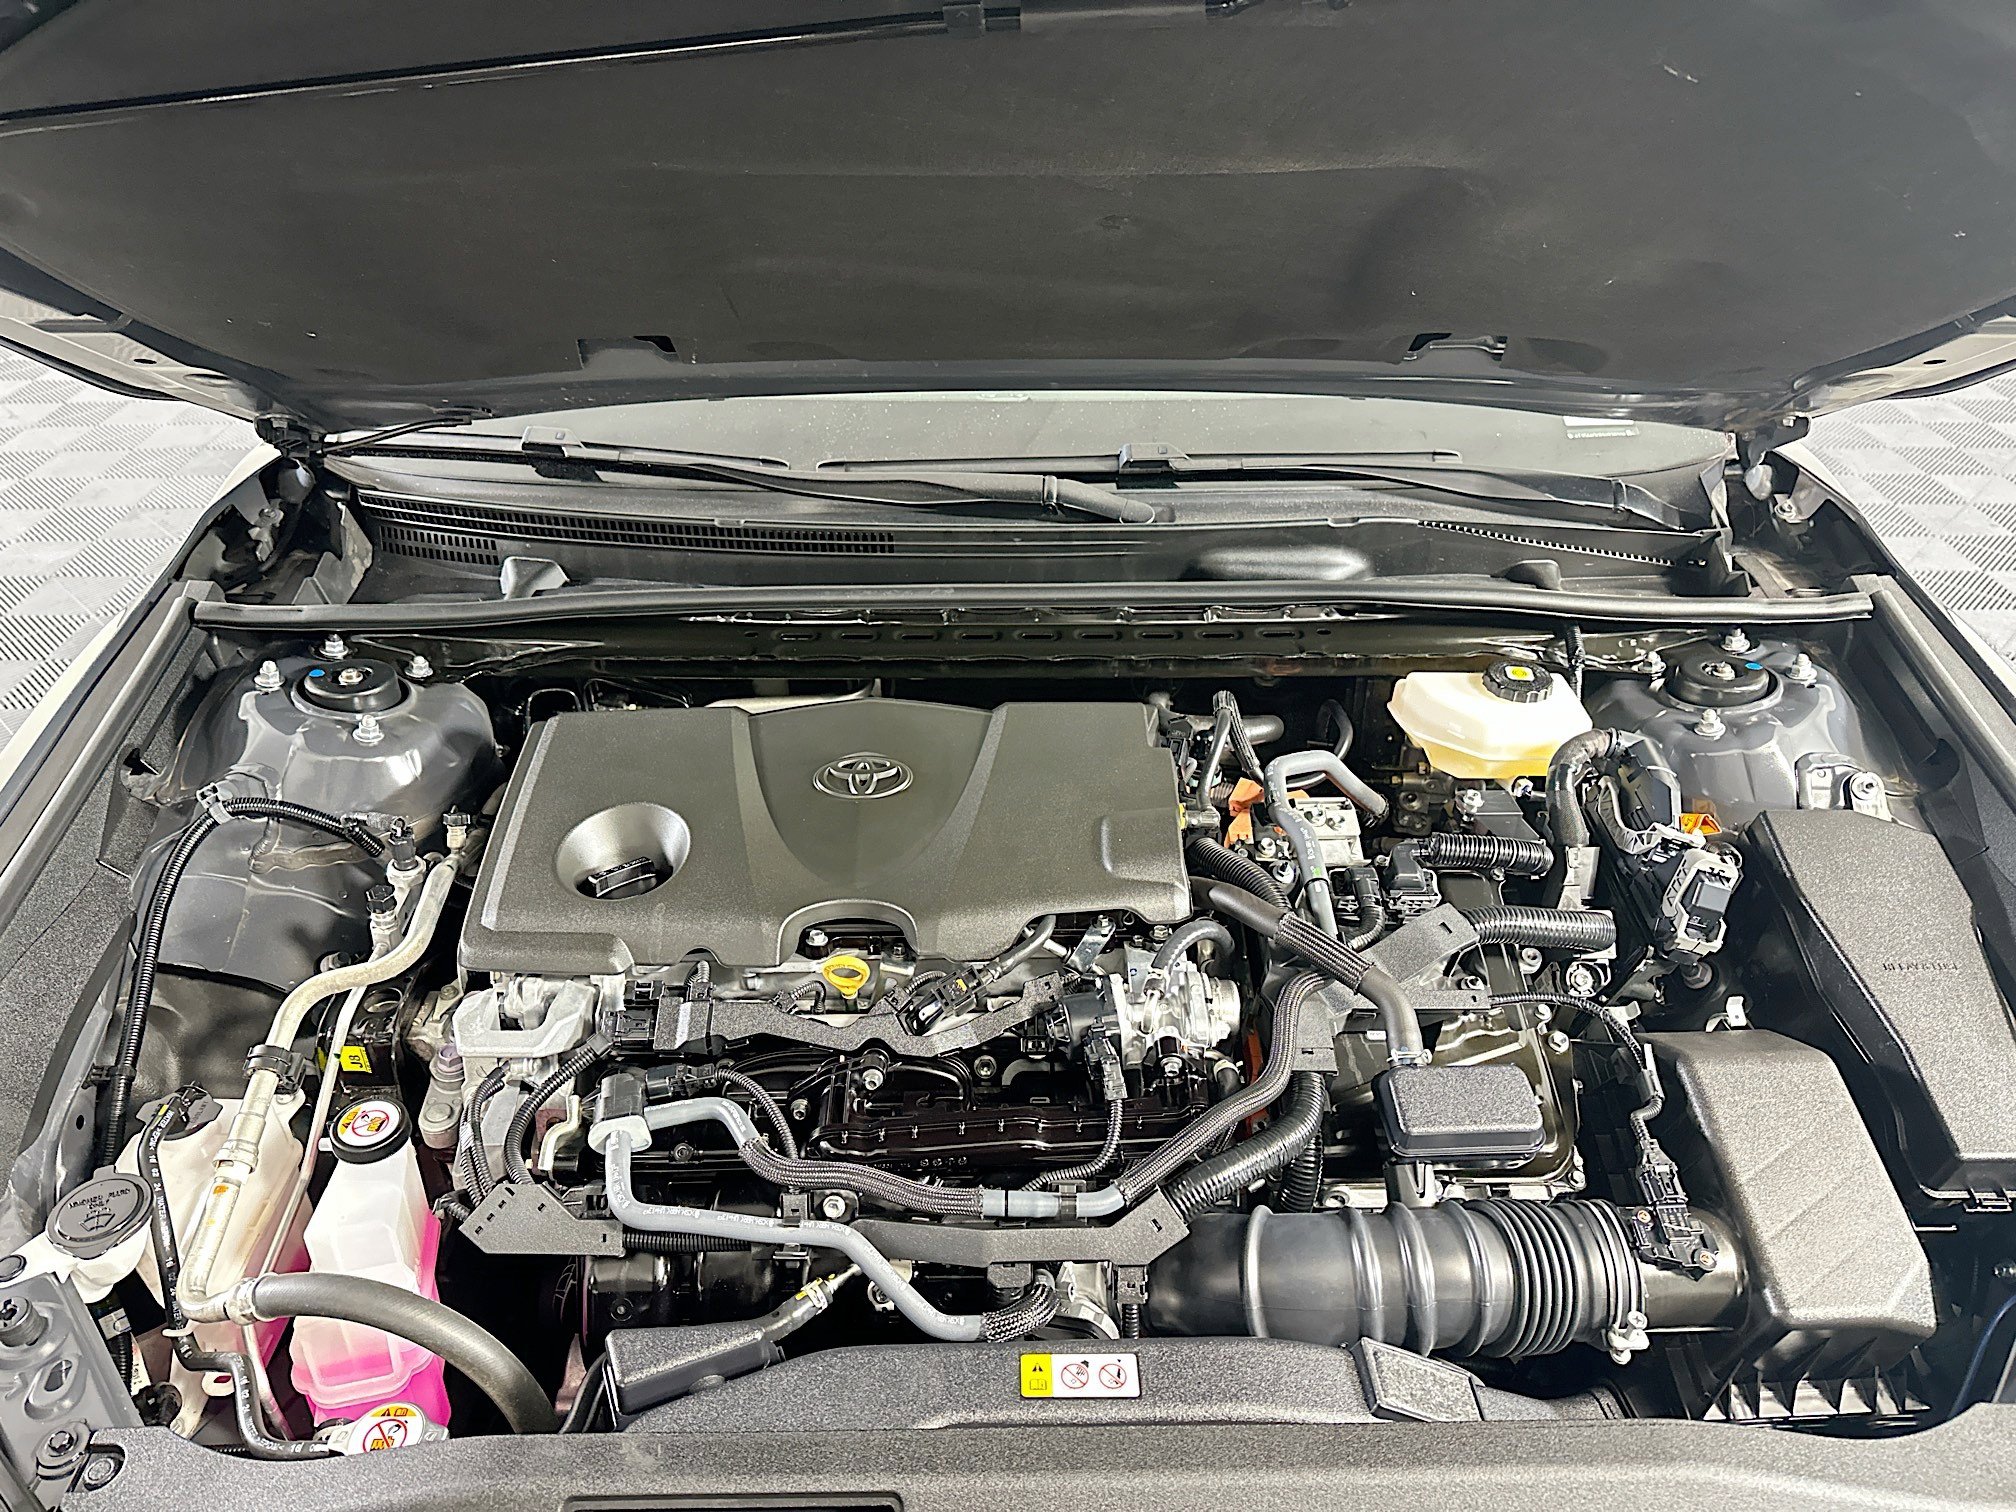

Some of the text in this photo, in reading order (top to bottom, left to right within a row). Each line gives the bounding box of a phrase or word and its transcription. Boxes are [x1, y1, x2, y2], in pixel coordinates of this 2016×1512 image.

[158, 1110, 175, 1128] WATER
[154, 1183, 162, 1192] 24
[156, 1195, 167, 1220] WATER
